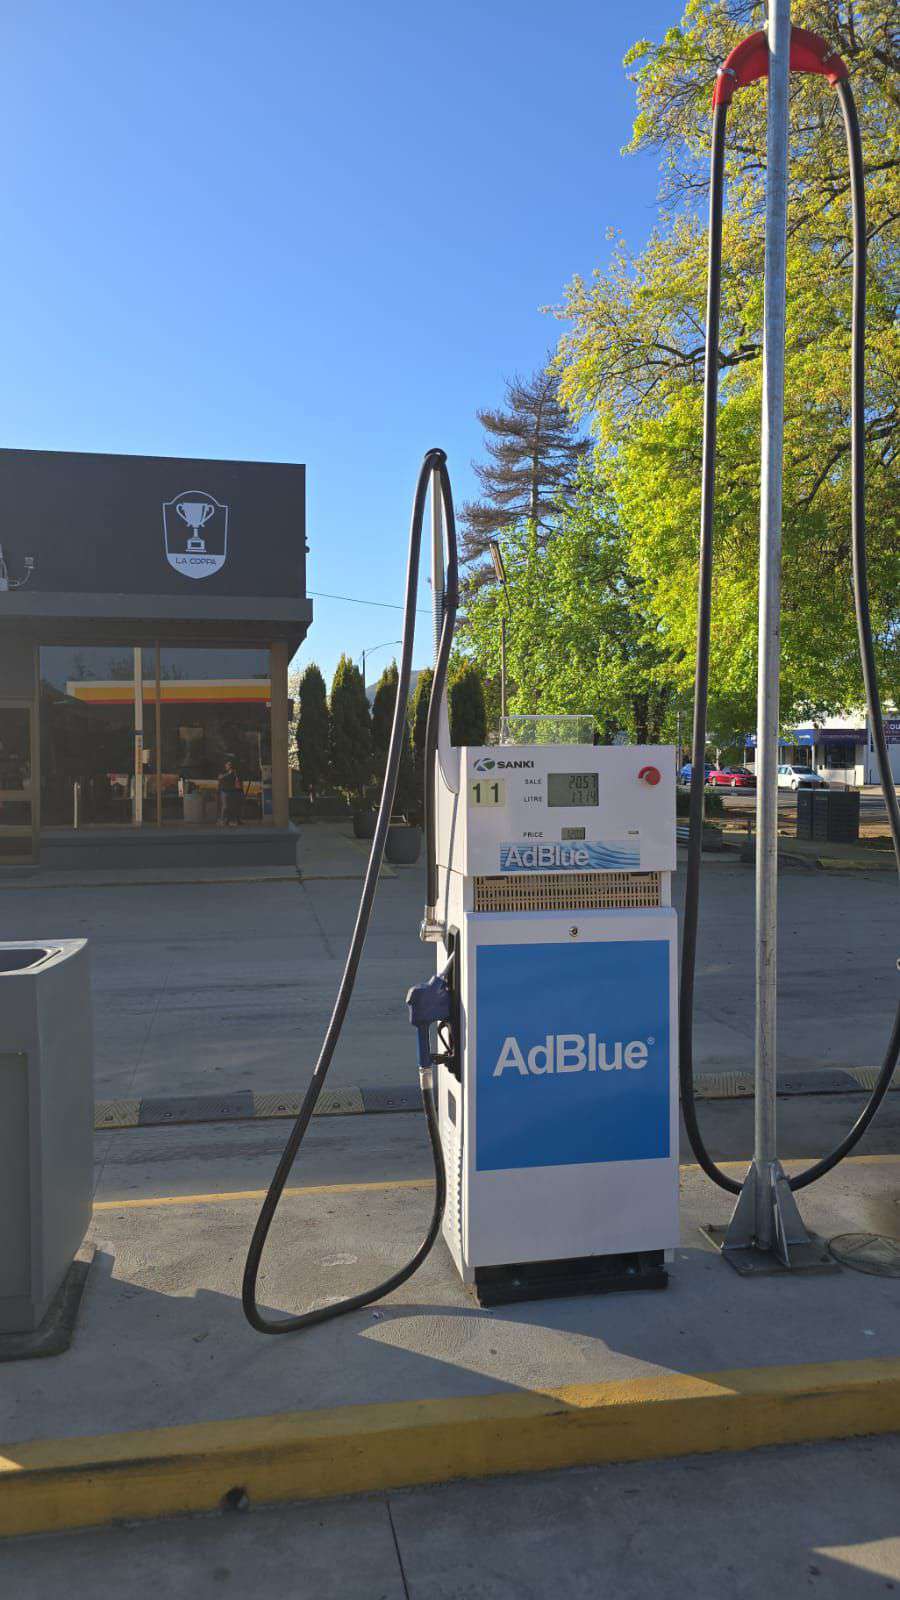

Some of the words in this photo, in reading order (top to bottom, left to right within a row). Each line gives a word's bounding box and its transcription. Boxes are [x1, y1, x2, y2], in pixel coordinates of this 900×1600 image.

[175, 557, 188, 565] LA
[189, 557, 217, 566] COPPA
[496, 760, 535, 769] SANKI
[504, 844, 590, 867] AdBlue
